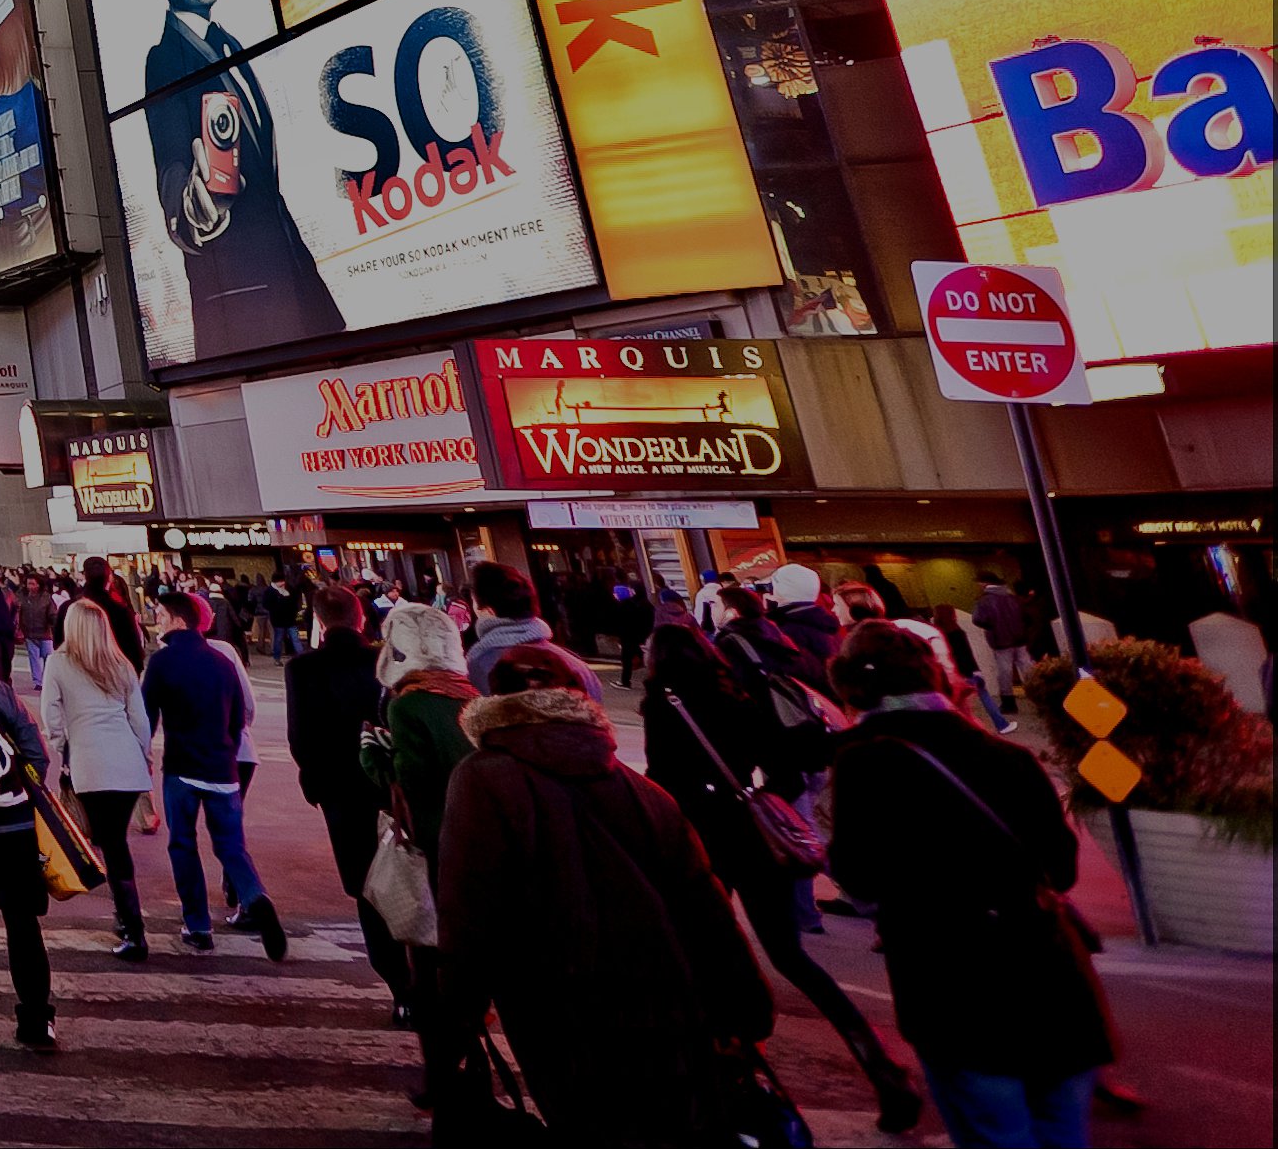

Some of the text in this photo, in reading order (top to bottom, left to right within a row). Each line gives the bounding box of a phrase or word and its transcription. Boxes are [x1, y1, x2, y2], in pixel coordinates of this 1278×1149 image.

[318, 7, 507, 197] SO
[348, 124, 516, 235] Kodak
[347, 259, 378, 278] SHARE
[380, 252, 407, 268] YOUR
[408, 250, 422, 263] SO
[423, 241, 460, 259] KODAK
[461, 227, 510, 248] MOMENT
[512, 219, 545, 238] HERE
[946, 291, 1037, 314] DO NOT
[495, 345, 764, 372] MARQUIS
[966, 350, 1049, 375] ENTER
[316, 357, 464, 439] Marriot
[69, 432, 149, 457] MARQUIS
[302, 436, 478, 473] NEW YORK MARQ
[521, 427, 783, 476] WONDERLAND
[579, 465, 588, 475] A
[589, 465, 614, 474] NEW
[651, 465, 661, 474] A
[661, 465, 685, 474] NEW
[75, 483, 155, 515] WONDERLAND
[648, 503, 657, 511] to
[658, 502, 669, 511] the
[670, 502, 691, 513] place
[693, 503, 715, 511] where
[600, 513, 632, 527] NOTHING
[665, 513, 692, 526] SEEMS
